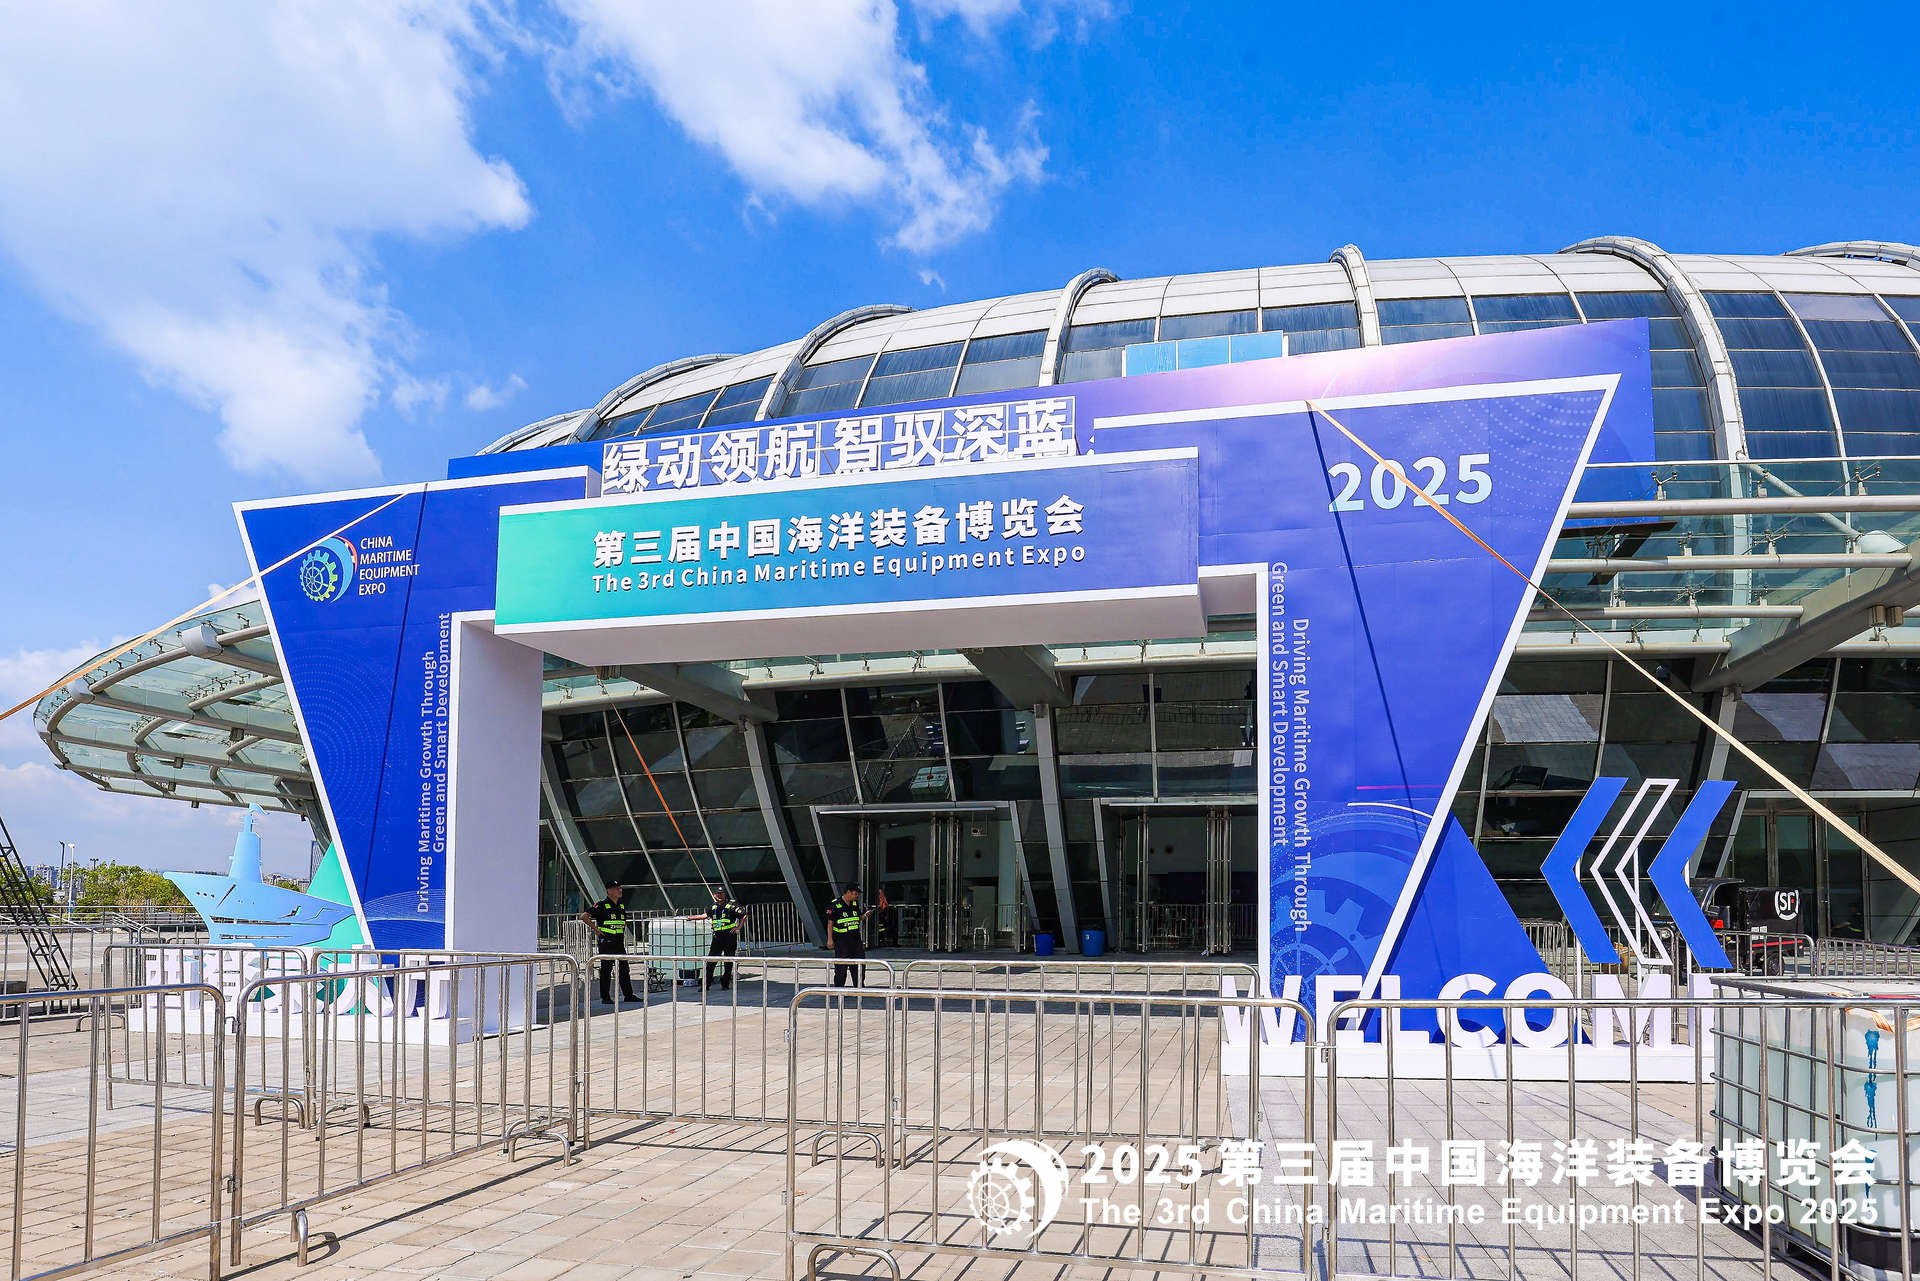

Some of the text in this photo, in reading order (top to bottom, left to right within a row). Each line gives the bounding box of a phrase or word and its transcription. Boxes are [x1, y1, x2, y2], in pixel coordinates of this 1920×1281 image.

[604, 399, 1068, 493] 绿动领航 智驭深蓝
[1327, 452, 1493, 513] 2025
[360, 535, 393, 550] CHINA
[360, 550, 412, 565] MARITIME
[592, 494, 1085, 568] 第三届中国海洋装备博览会
[359, 564, 420, 581] EQUIPMENT
[359, 583, 386, 596] EXPO
[593, 544, 1086, 592] The 3rd China Maritime Equipment Expo
[433, 612, 450, 853] Green and Smart Development
[1270, 561, 1291, 847] Green and Smart Development
[417, 650, 437, 913] Driving Maritime Growth Through
[1289, 618, 1312, 932] Driving Maritime Growth Through
